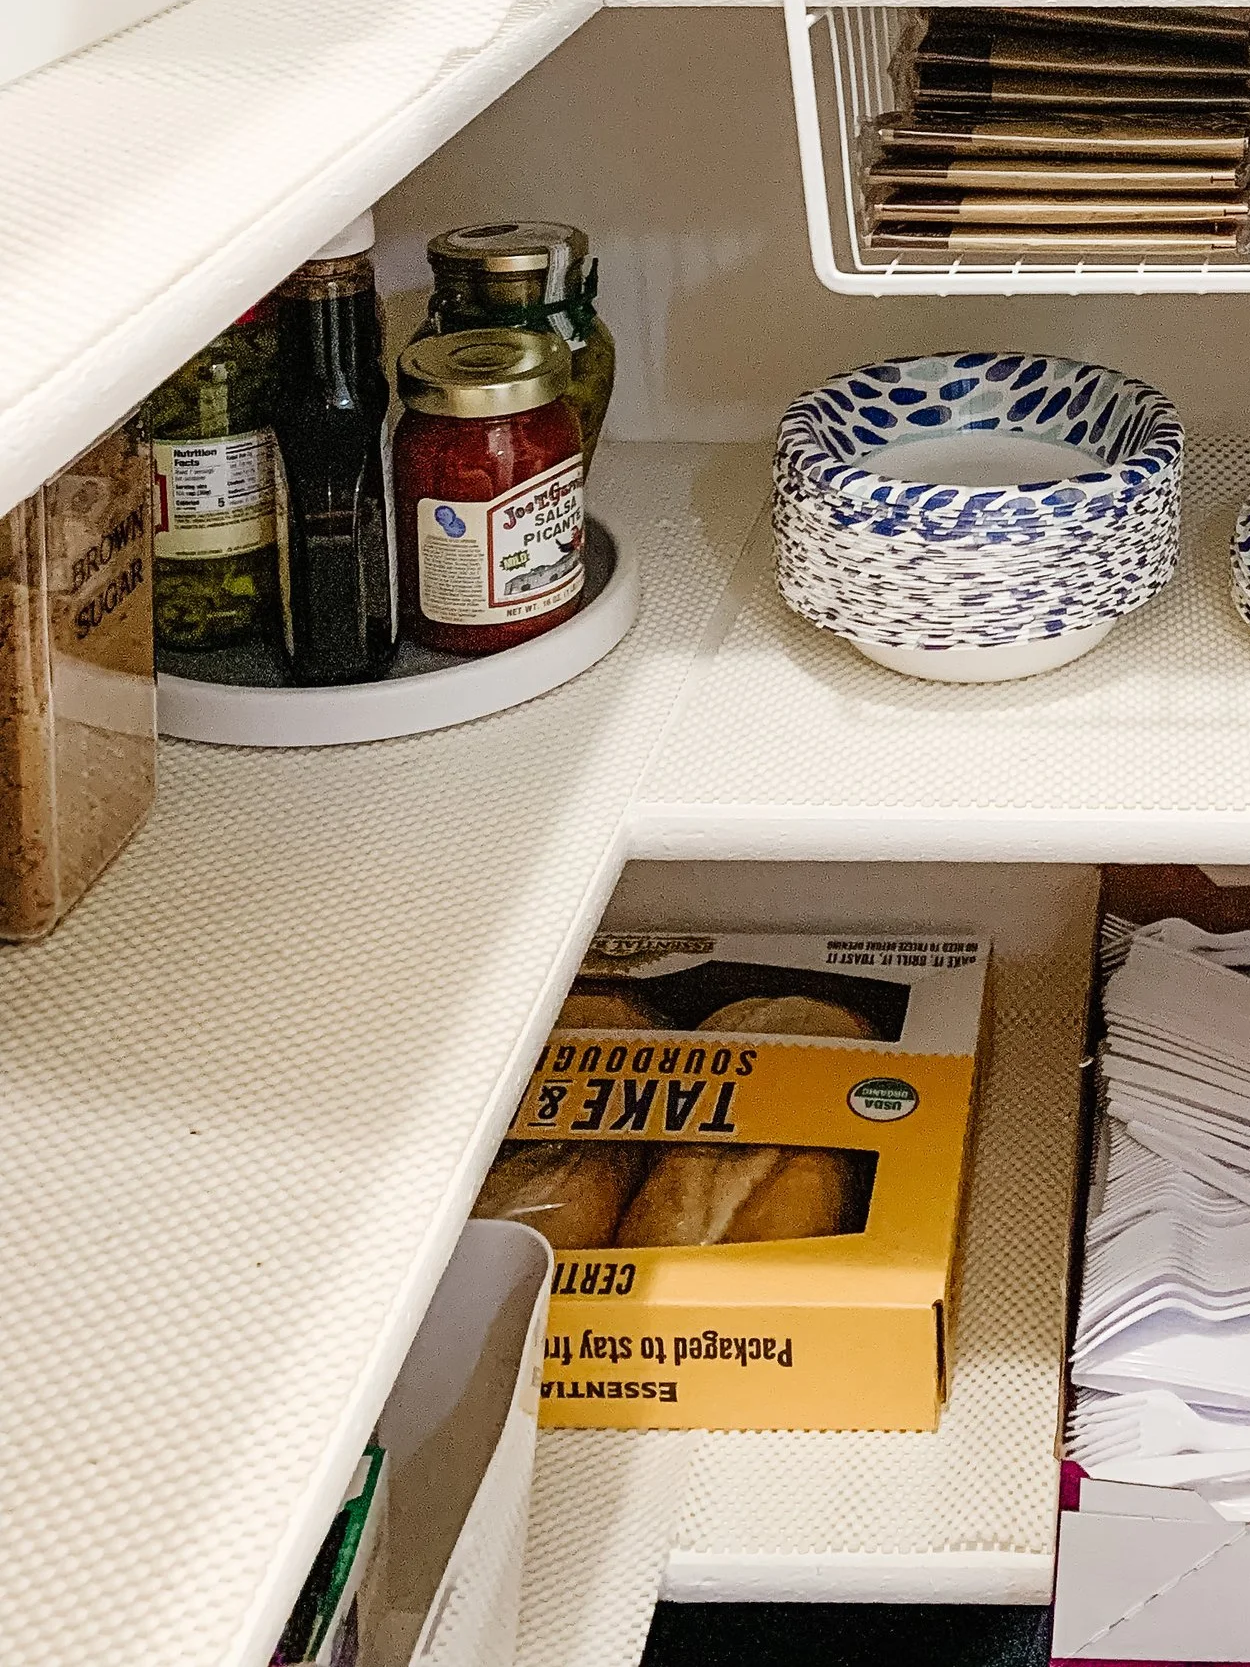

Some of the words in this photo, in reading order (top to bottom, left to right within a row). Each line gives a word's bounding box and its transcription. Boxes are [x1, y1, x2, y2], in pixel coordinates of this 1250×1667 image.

[174, 449, 217, 458] Nutrition
[174, 459, 200, 467] Facts
[217, 497, 226, 508] 5
[534, 495, 577, 527] SALSA
[503, 500, 534, 530] Joe
[523, 506, 582, 547] PICANTE
[75, 557, 144, 640] SUGAR
[506, 606, 523, 617] NET
[898, 941, 928, 952] FREEZE
[826, 952, 838, 965] IT
[839, 952, 875, 965] TOAST
[861, 1087, 909, 1099] ORGANIC
[571, 1078, 737, 1134] TAKE
[864, 1099, 902, 1111] USDA
[552, 1262, 636, 1296] CERTI
[579, 1329, 633, 1365] stay
[640, 1336, 667, 1365] to
[673, 1330, 793, 1368] Packaged
[540, 1381, 678, 1403] ESSENTIA
